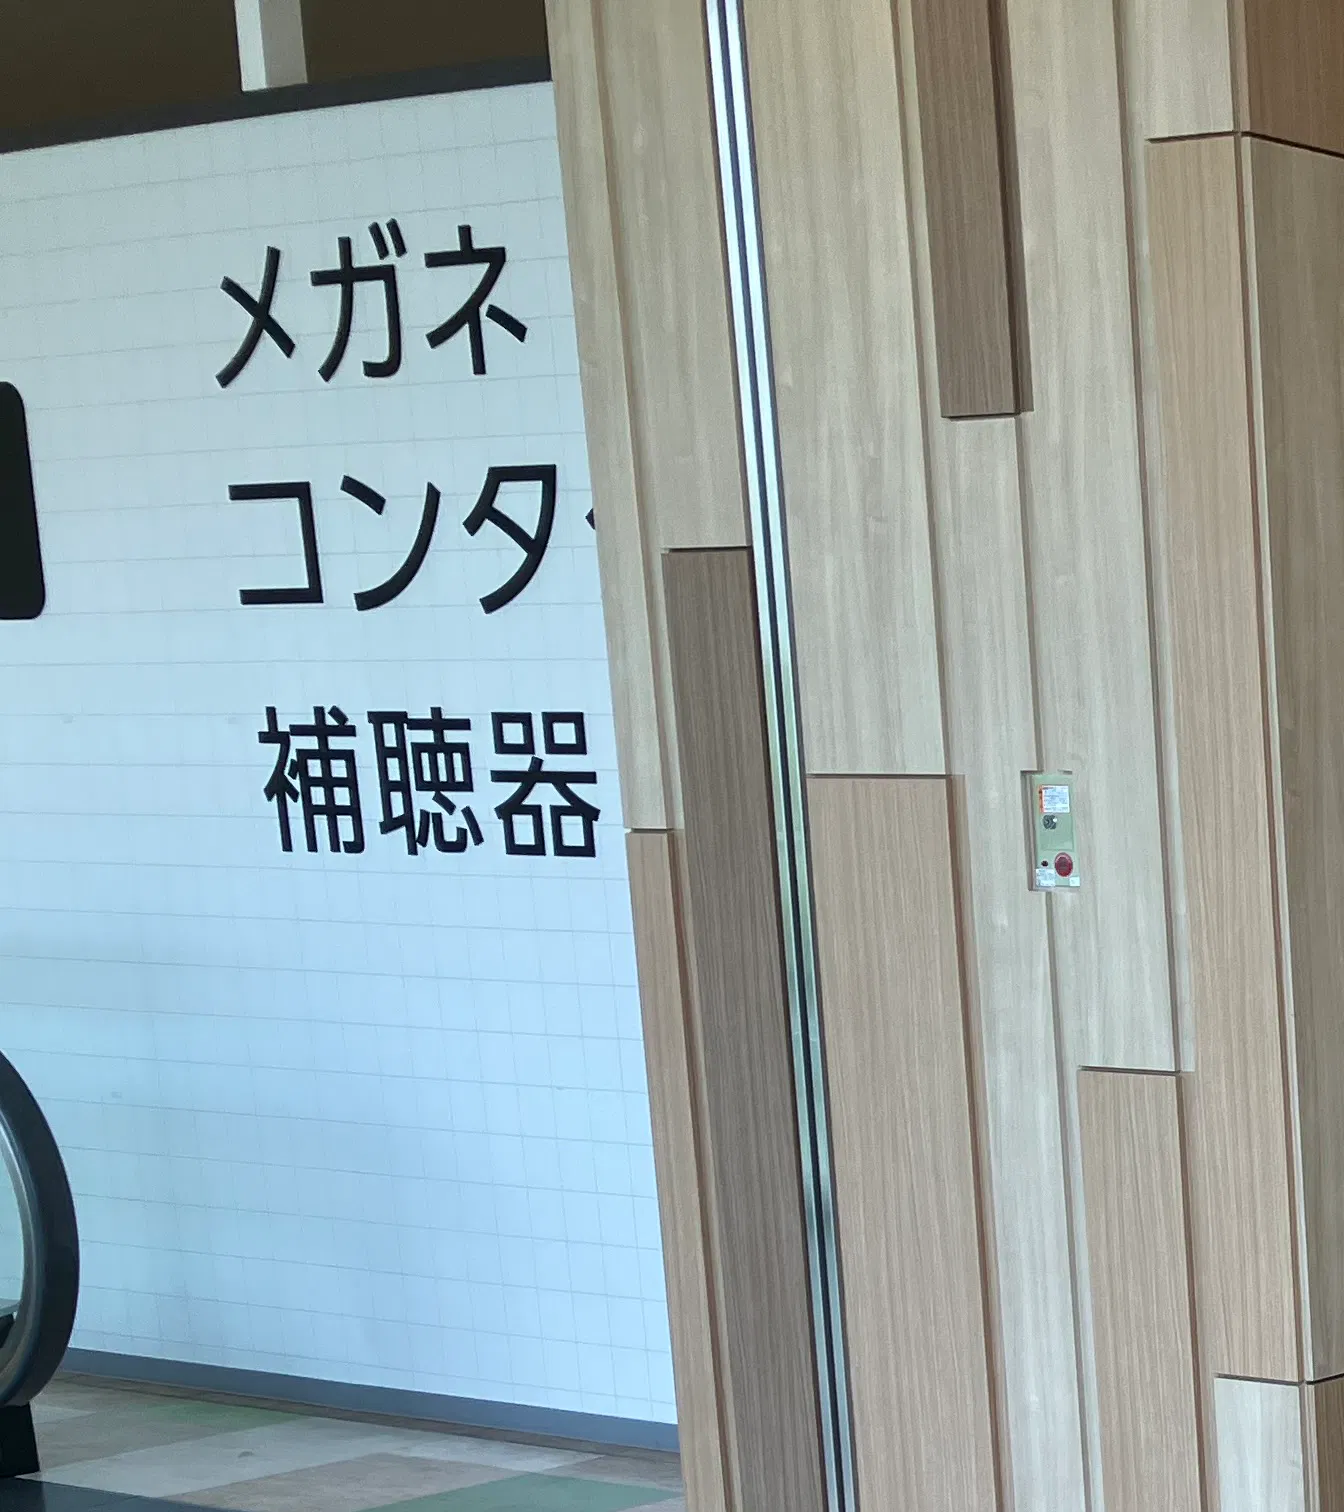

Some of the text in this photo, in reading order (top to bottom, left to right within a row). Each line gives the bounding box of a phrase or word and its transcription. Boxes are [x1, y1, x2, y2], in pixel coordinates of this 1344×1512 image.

[215, 217, 528, 389] メガネ
[229, 463, 597, 614] コンタ
[259, 704, 602, 859] 補聴器
